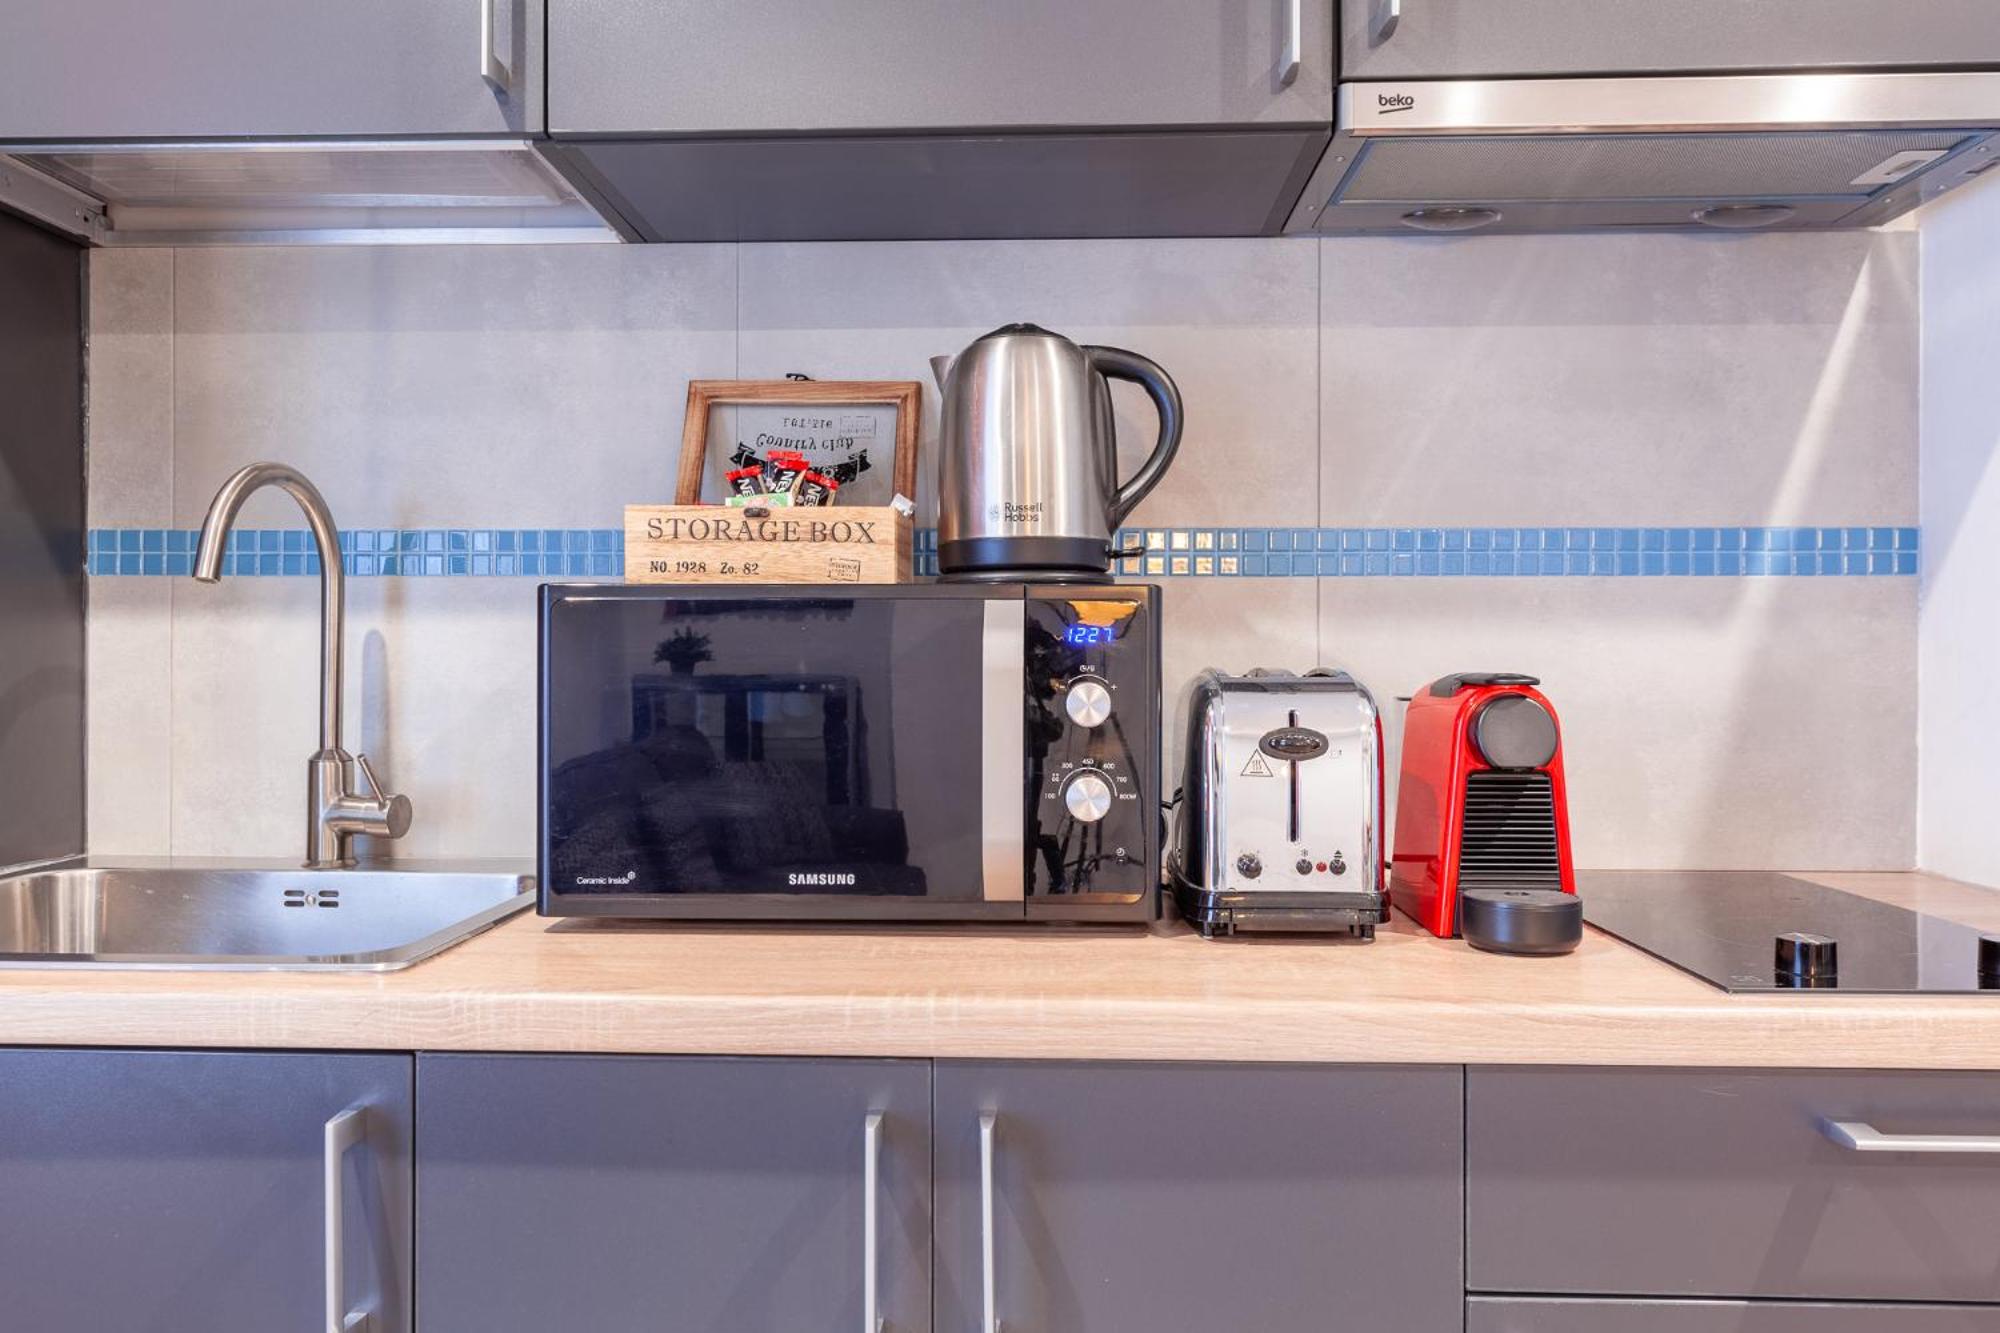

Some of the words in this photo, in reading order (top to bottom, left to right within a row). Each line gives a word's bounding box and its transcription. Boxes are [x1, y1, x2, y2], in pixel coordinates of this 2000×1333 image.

[1378, 93, 1414, 108] beko
[1004, 502, 1043, 512] Russell
[647, 518, 801, 542] STORAGE
[811, 520, 876, 544] BOX
[650, 560, 671, 573] NO.
[676, 561, 707, 574] 1928
[743, 562, 760, 575] 82
[576, 876, 607, 885] Ceramic
[608, 876, 630, 885] Inside
[788, 873, 856, 886] SAMSUNG
